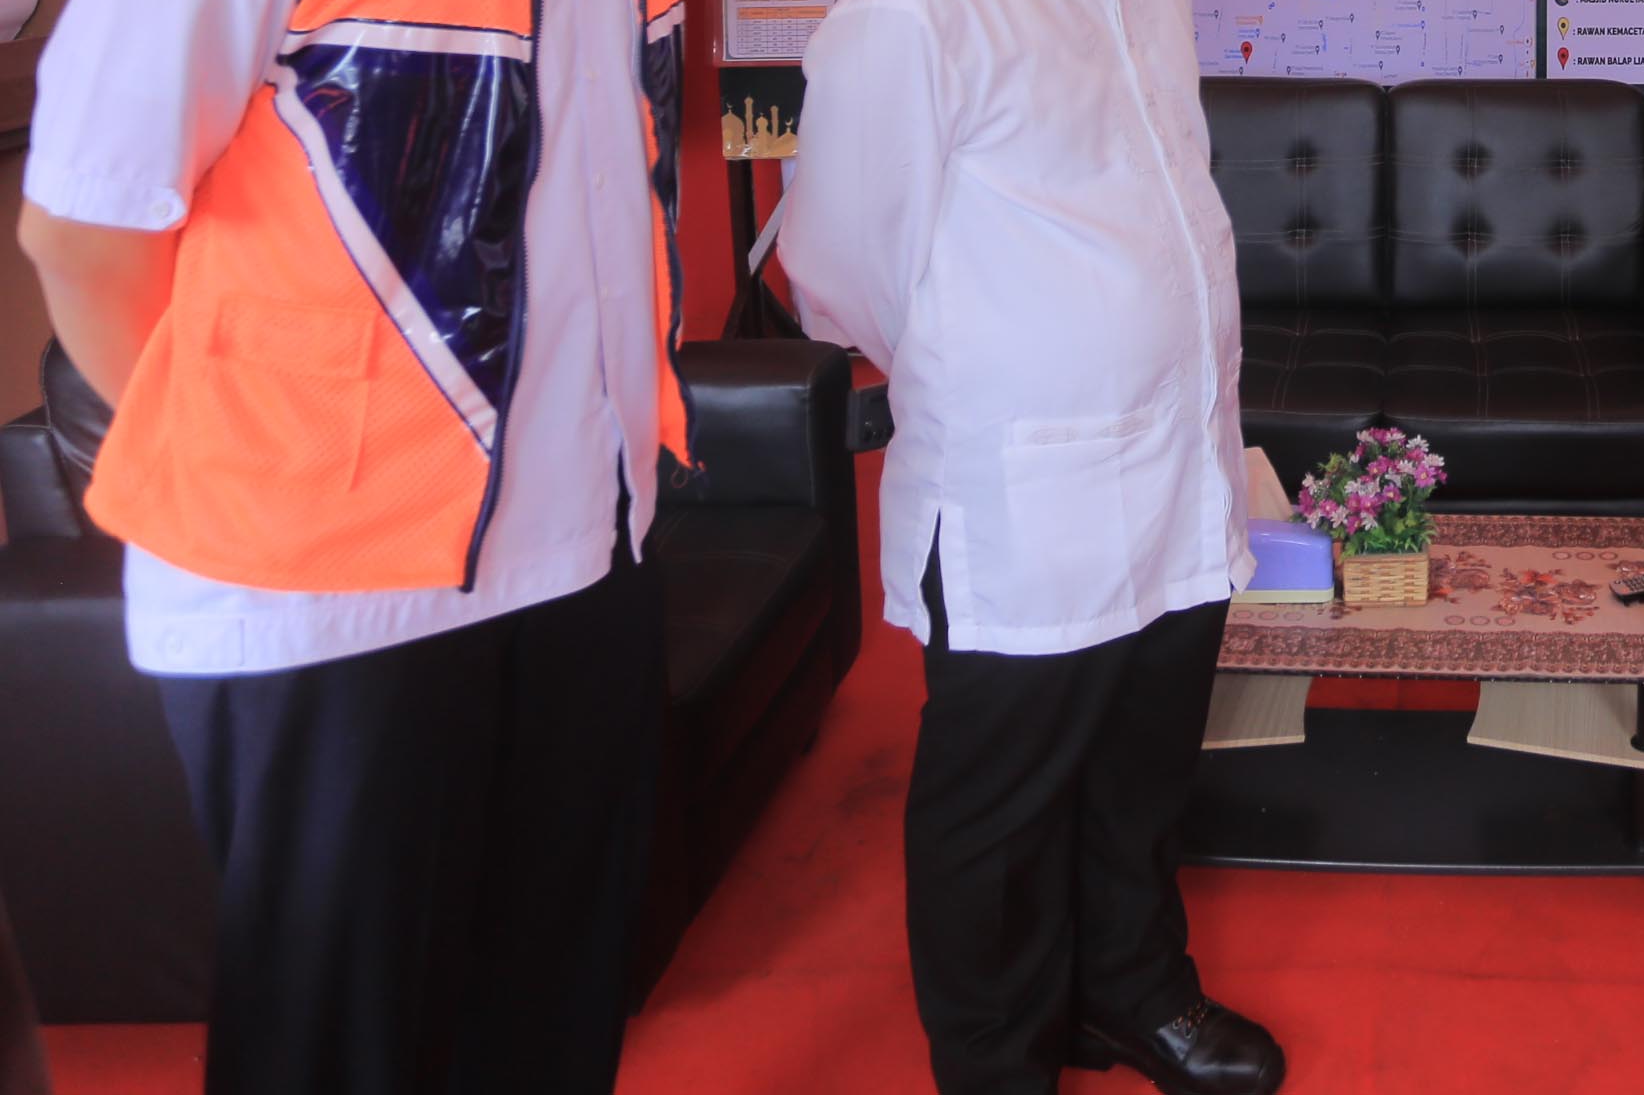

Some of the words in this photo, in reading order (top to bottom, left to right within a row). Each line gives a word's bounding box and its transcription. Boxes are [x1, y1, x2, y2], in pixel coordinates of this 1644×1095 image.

[1577, 27, 1605, 35] RAWAN
[1577, 57, 1606, 65] RAWAN
[1607, 57, 1632, 65] BALAP
